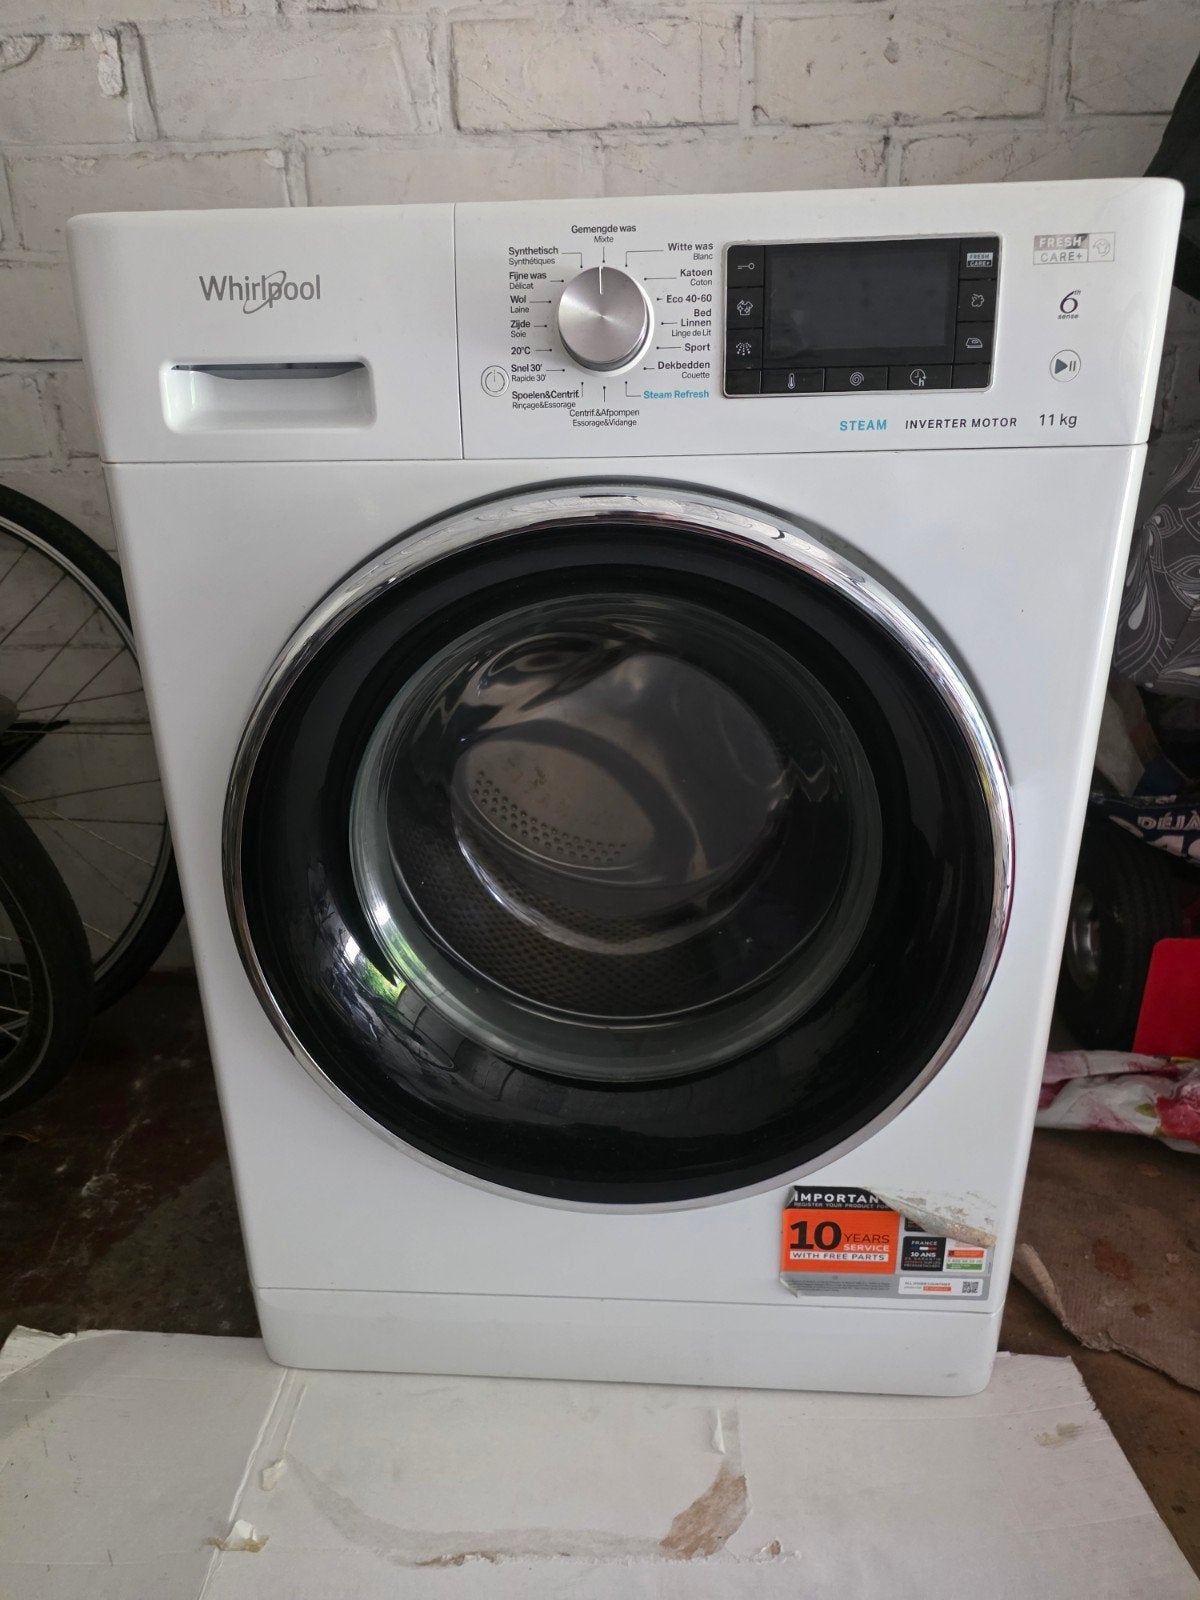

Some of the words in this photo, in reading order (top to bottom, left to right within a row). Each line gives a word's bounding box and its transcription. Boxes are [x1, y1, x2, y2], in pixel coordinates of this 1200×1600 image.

[571, 225, 618, 235] Gemengde
[593, 235, 614, 243] Mixte
[1038, 237, 1082, 248] FRESH
[667, 242, 693, 251] Witte
[508, 246, 559, 257] Synthetisch
[693, 252, 713, 260] Blanc
[508, 257, 556, 266] Synthétiques
[1040, 251, 1083, 263] CARE+
[509, 271, 529, 281] Fijne
[679, 268, 713, 277] Katoen
[509, 282, 534, 290] Délicat
[690, 278, 713, 286] Coton
[198, 270, 321, 314] Whirlpool
[510, 295, 527, 304] Wol
[666, 294, 684, 303] Eco
[685, 294, 713, 303] 40-60
[693, 308, 712, 317] Bed
[510, 320, 531, 329] Zijde
[680, 318, 712, 327] Linnen
[510, 330, 527, 338] Soie
[671, 329, 691, 338] Linge
[692, 329, 701, 337] de
[702, 329, 712, 337] Lit
[684, 343, 711, 353] Sport
[511, 364, 529, 372] Snel
[657, 361, 710, 370] Dekbedden
[511, 375, 536, 383] Rapide
[681, 371, 710, 379] Couette
[511, 390, 580, 401] Spoelen&Centrif.
[643, 390, 672, 399] Steam
[674, 389, 710, 399] Refresh
[512, 401, 576, 411] Rinçage&Essorage
[569, 408, 640, 419] Centrif.&Afpompen
[572, 418, 637, 428] Essorage&Vidange
[839, 419, 888, 431] STEAM
[904, 418, 967, 429] INVERTER
[971, 416, 1018, 428] MOTOR
[1039, 414, 1056, 426] 11
[1060, 413, 1078, 428] kg
[794, 1190, 880, 1204] IMPORTAN
[790, 1220, 842, 1250] 10
[844, 1233, 890, 1244] YEARS
[843, 1243, 890, 1252] SERVICE
